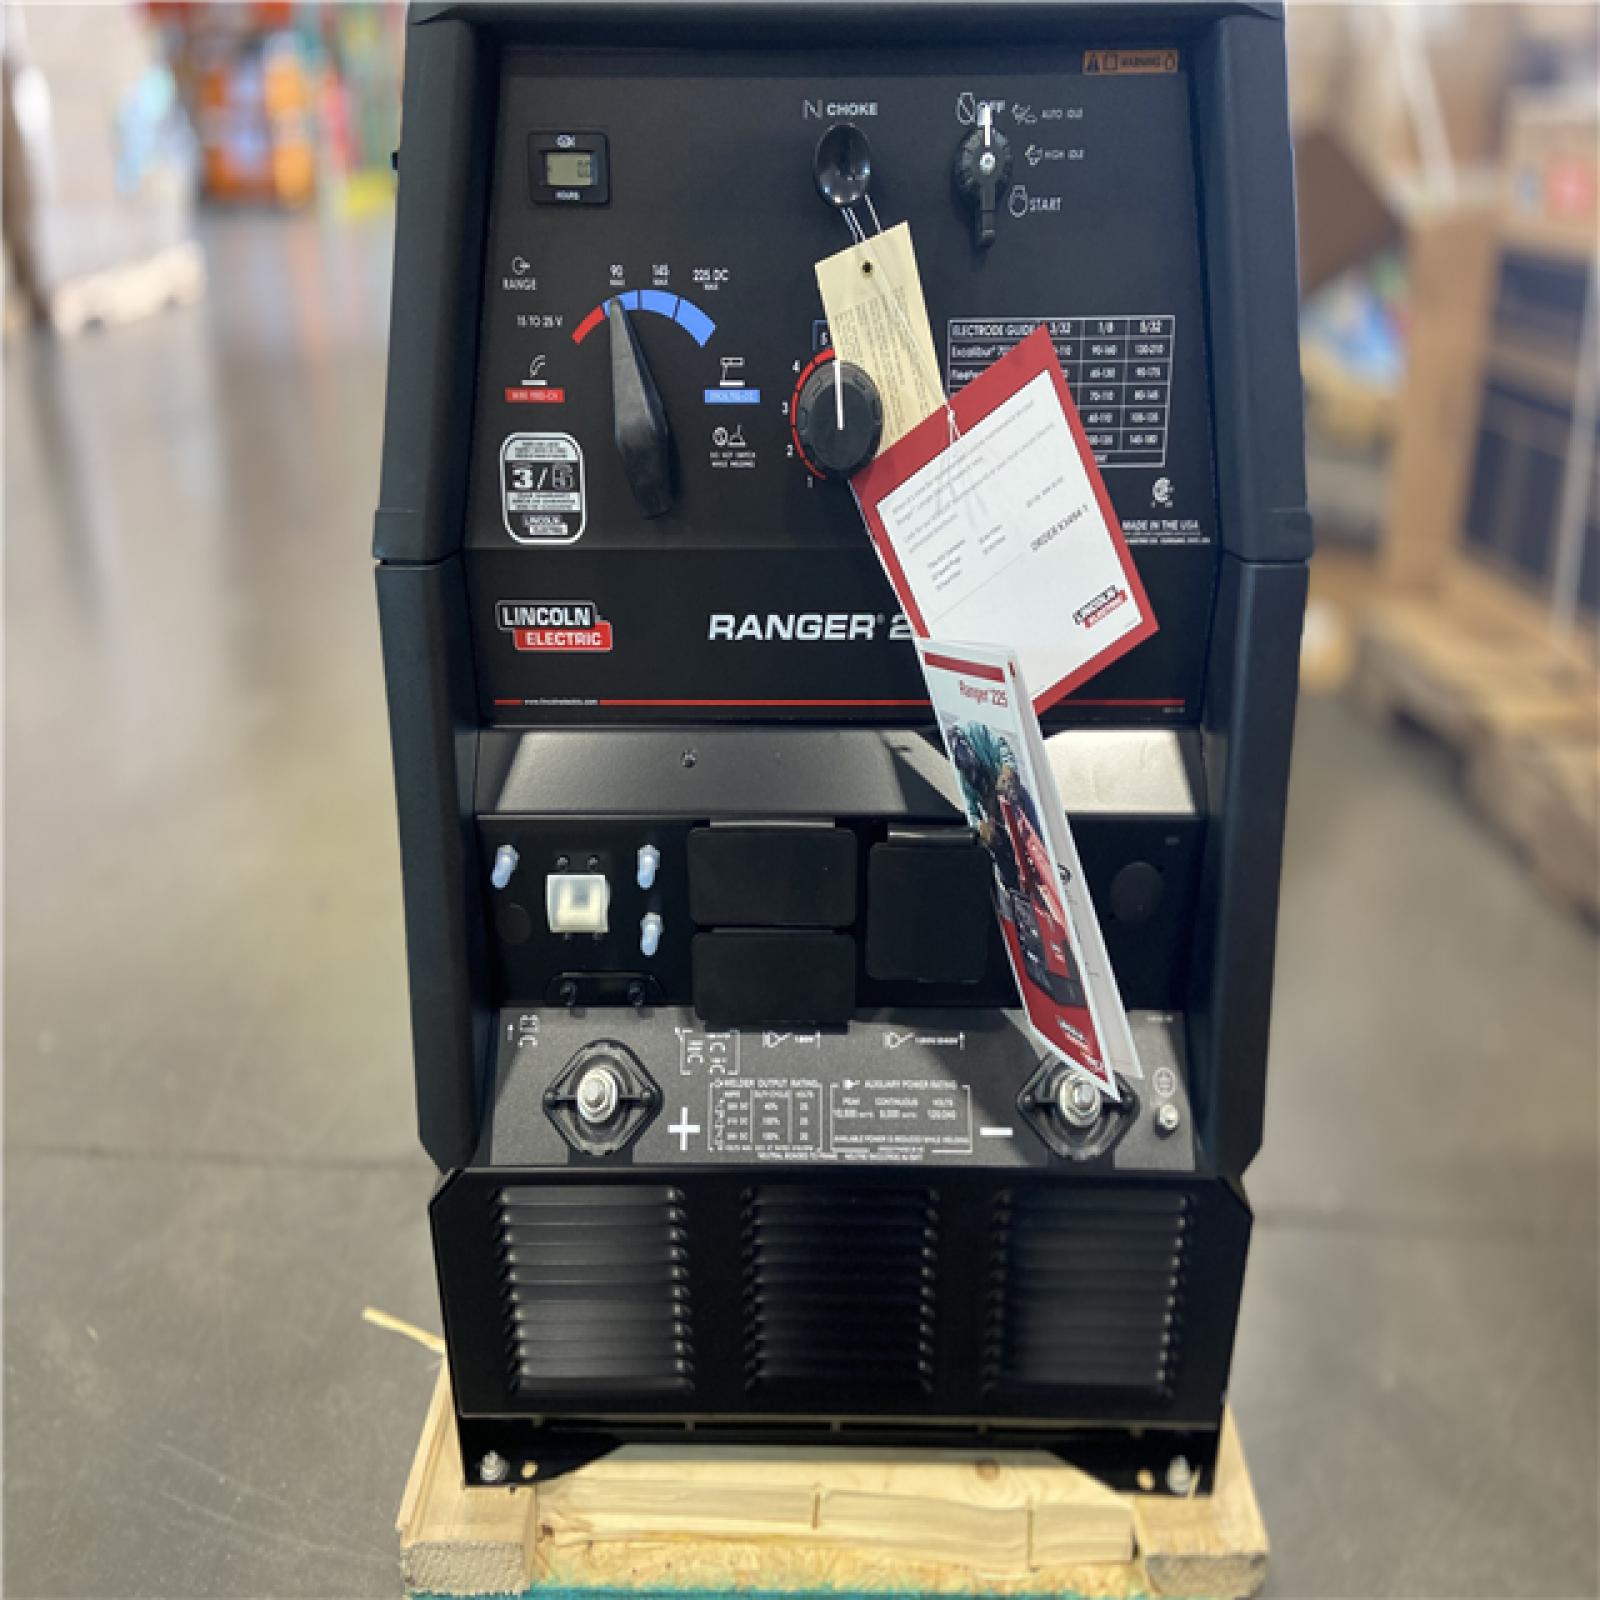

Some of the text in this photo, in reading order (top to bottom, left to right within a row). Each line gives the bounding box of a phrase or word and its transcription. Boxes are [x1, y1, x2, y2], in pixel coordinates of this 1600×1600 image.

[827, 102, 879, 116] CHOKE
[1030, 197, 1062, 211] START
[503, 279, 536, 290] RANGE
[952, 324, 1003, 336] ELECTRODE
[782, 402, 789, 415] 3
[1122, 519, 1148, 531] MADE
[1162, 519, 1178, 531] THE
[502, 606, 592, 627] LINCOLN
[525, 631, 603, 646] ELECTRIC
[959, 679, 989, 704] Ranger
